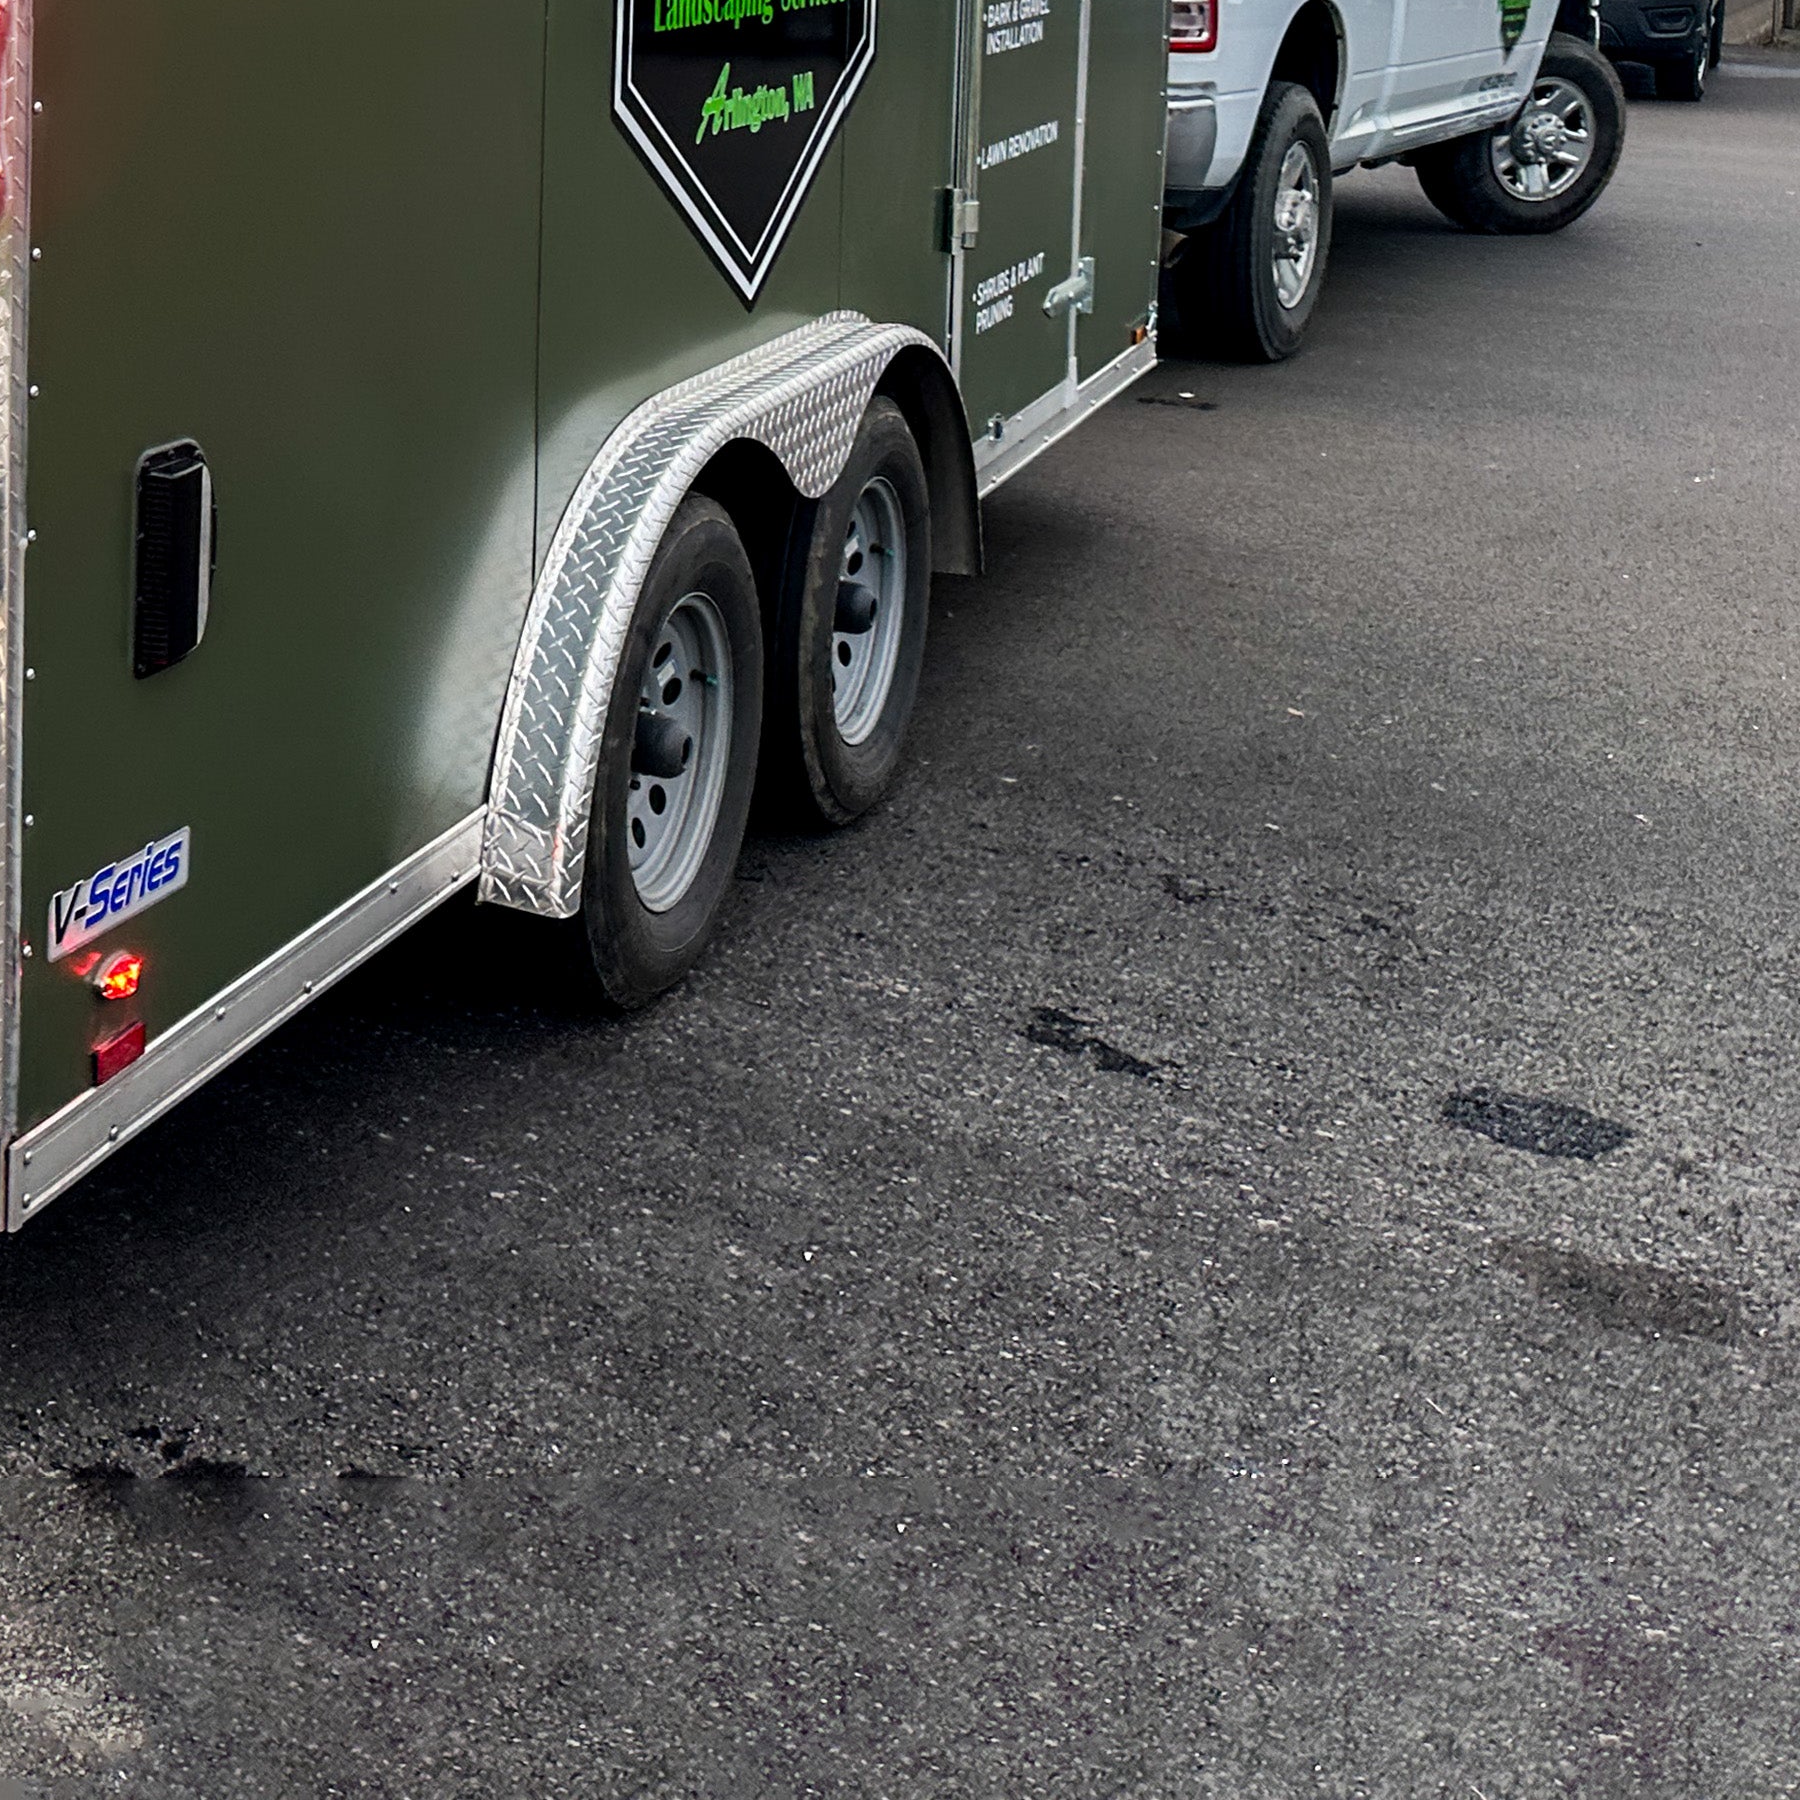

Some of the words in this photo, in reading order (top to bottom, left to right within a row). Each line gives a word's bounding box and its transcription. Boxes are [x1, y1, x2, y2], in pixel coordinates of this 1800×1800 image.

[986, 20, 1044, 55] INSTALLATION
[987, 0, 1012, 28] BARK
[695, 61, 790, 144] Arlington,
[793, 71, 815, 115] WA
[981, 138, 1007, 170] LAWN
[1008, 120, 1059, 160] RENOVATION
[977, 269, 1010, 306] SHRUBS
[1017, 252, 1045, 285] PLANT
[976, 294, 1014, 335] PRUNING
[54, 839, 184, 945] V-Series
